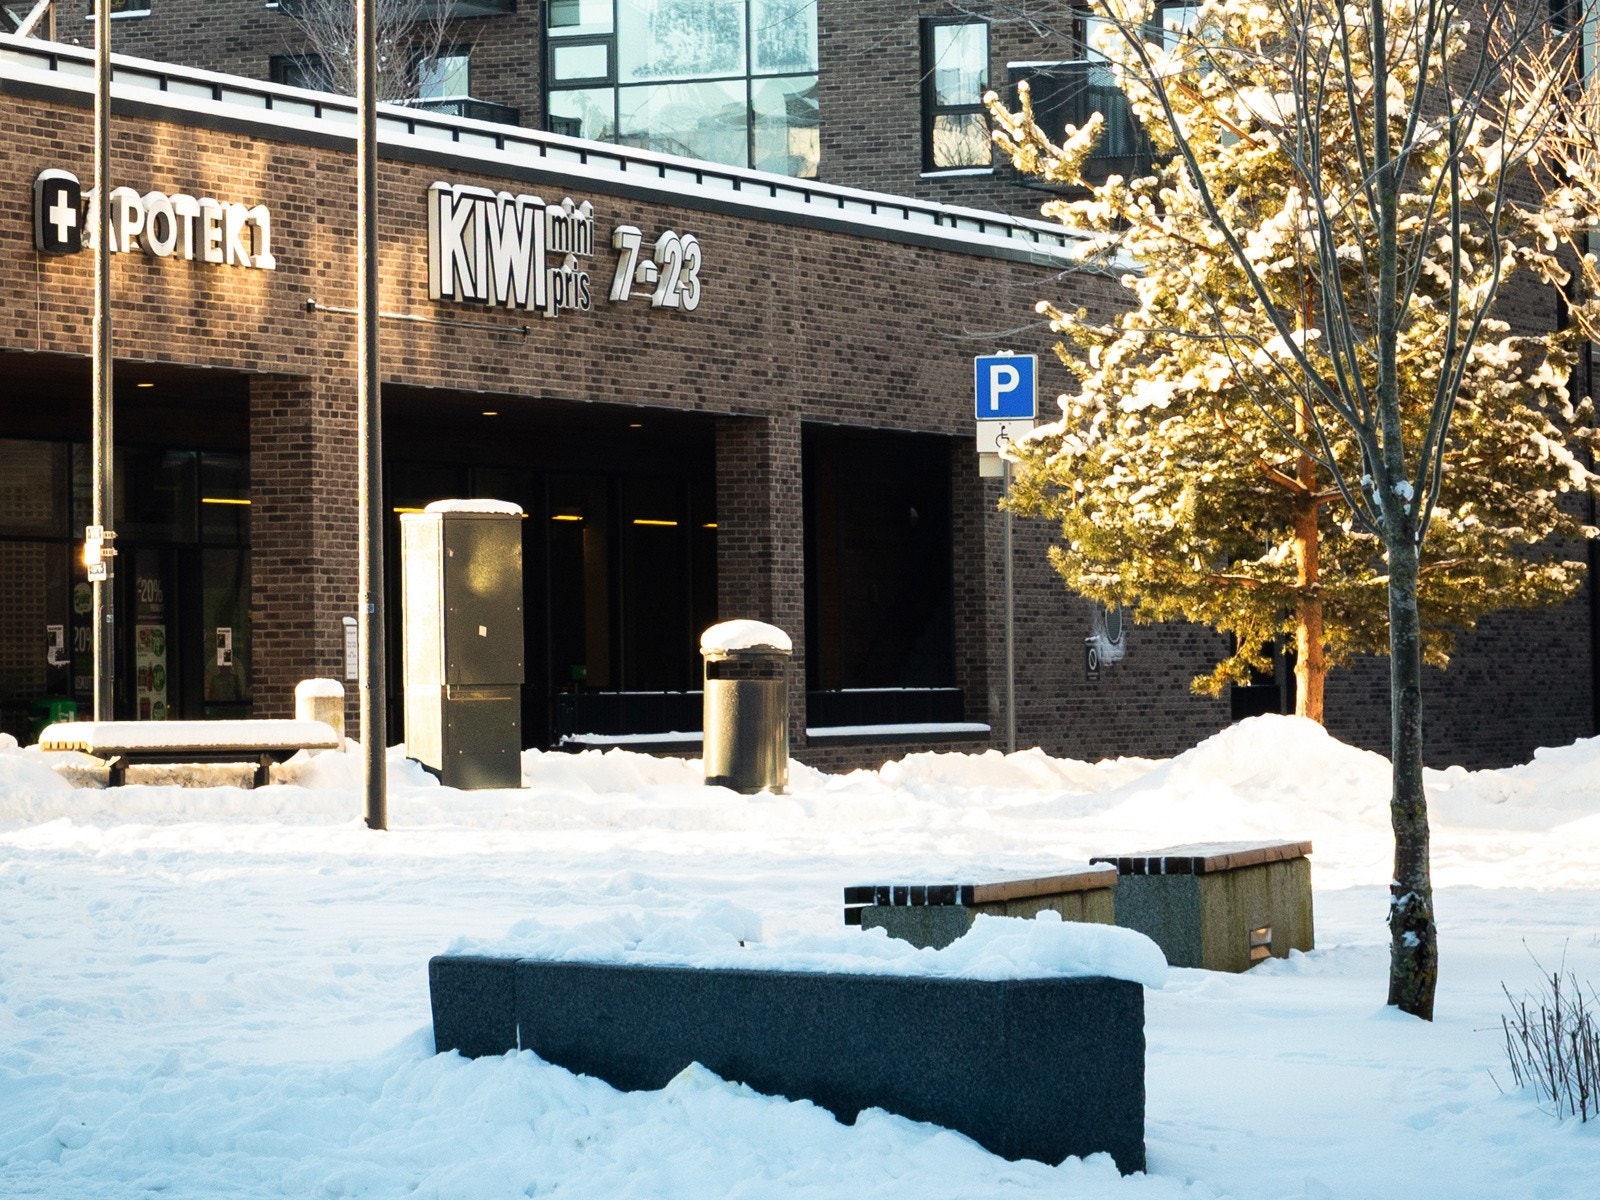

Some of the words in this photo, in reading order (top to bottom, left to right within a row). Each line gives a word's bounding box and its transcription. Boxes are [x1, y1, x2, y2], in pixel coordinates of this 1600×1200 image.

[431, 186, 546, 311] KIWI
[549, 203, 594, 256] mini
[550, 260, 591, 318] pris
[611, 229, 702, 312] 7-23
[989, 364, 1020, 411] P
